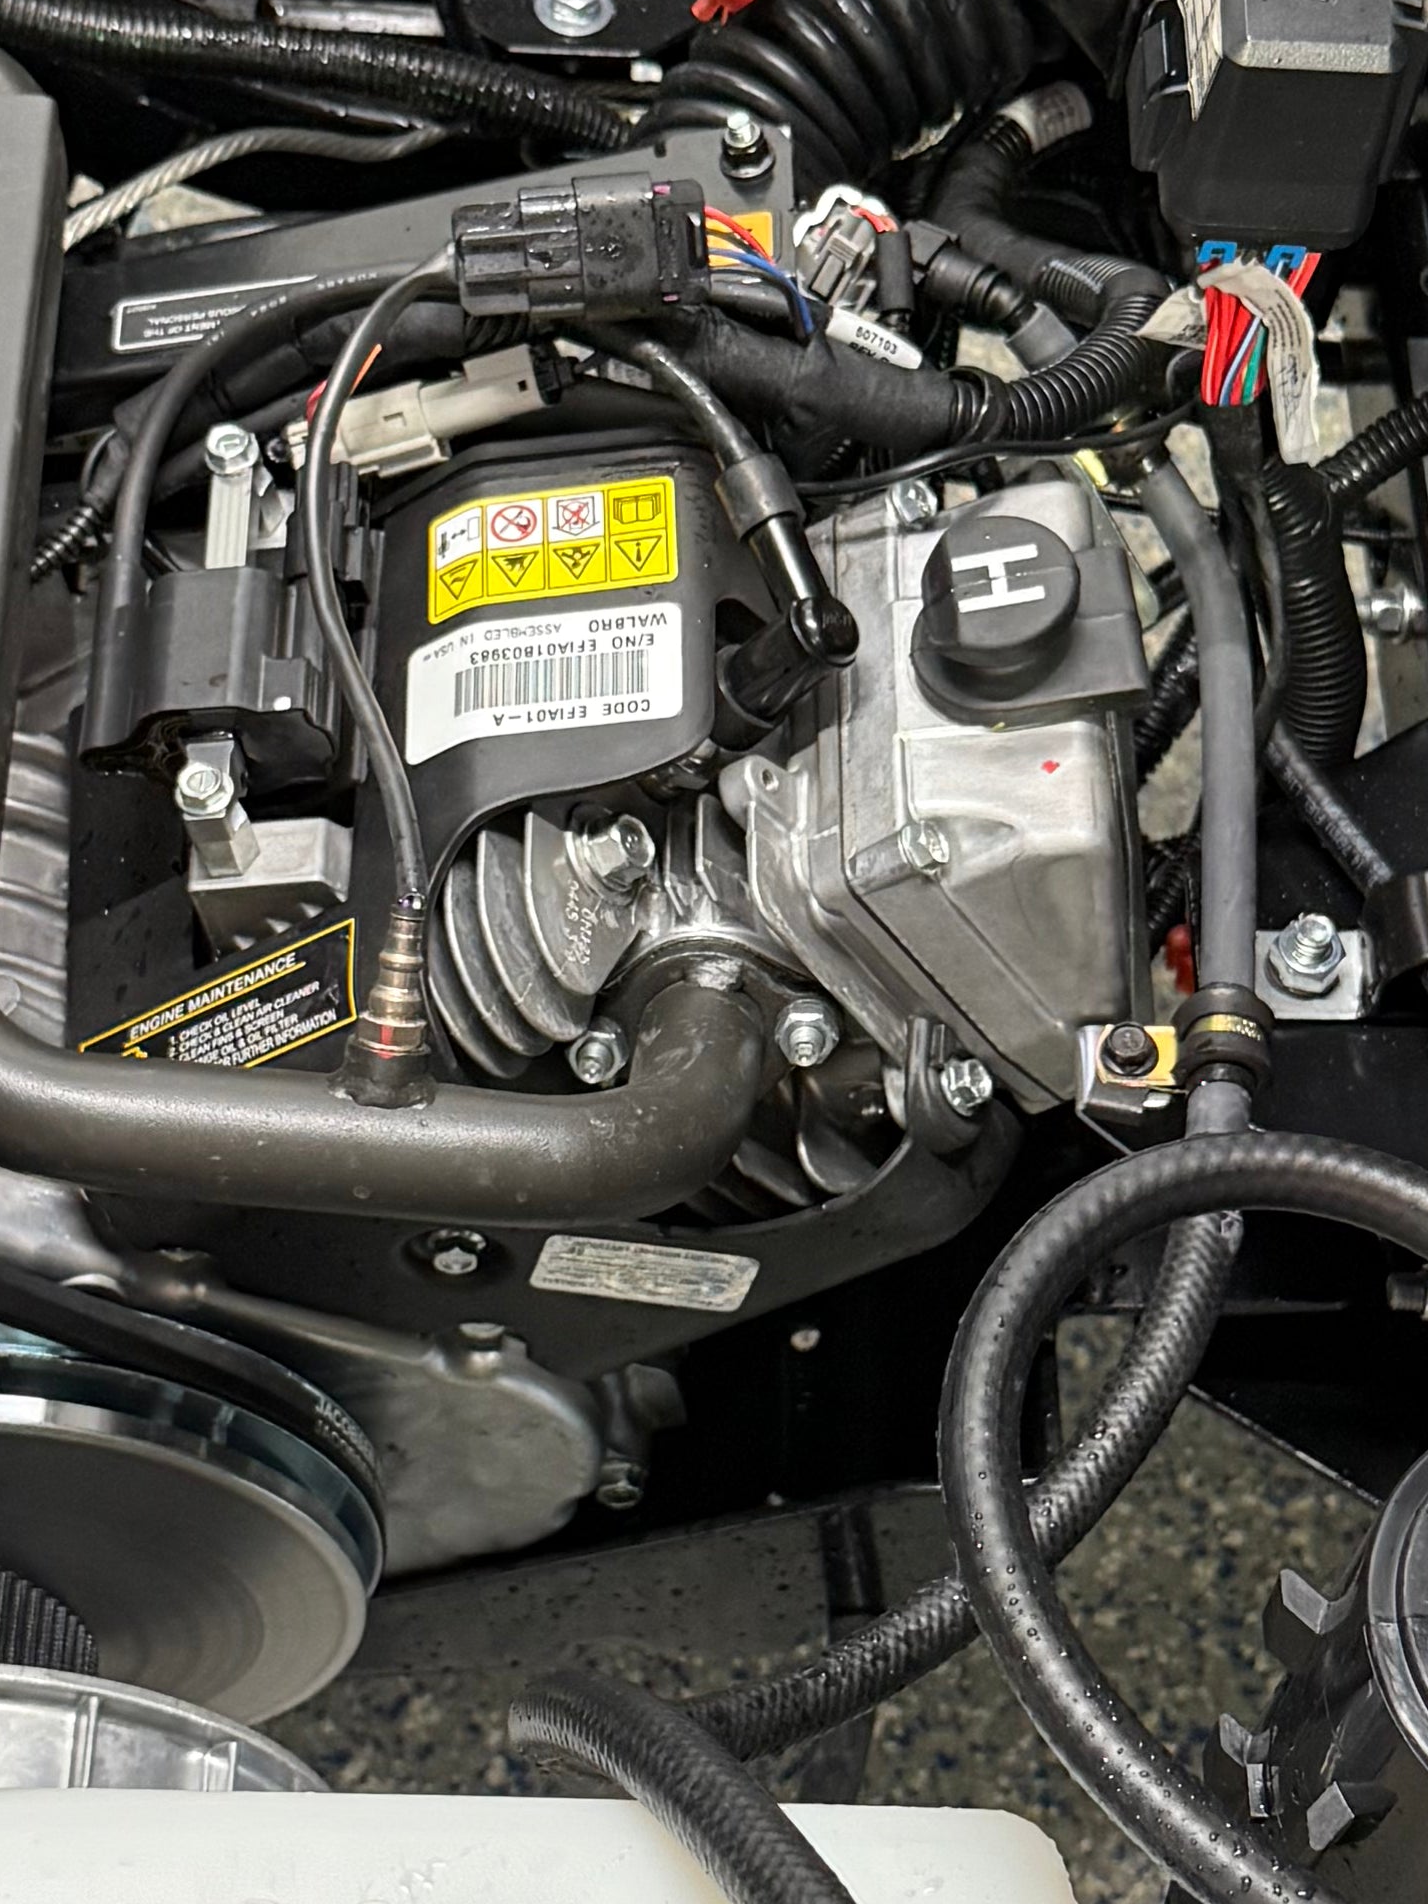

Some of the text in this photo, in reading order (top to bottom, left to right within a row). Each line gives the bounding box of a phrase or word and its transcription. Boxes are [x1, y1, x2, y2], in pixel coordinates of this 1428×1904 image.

[952, 543, 1045, 613] H
[433, 612, 667, 658] WALBRO ASSEMBLED IN USA
[470, 633, 655, 666] E/NO EFIA01B03983
[602, 698, 651, 716] CODE
[129, 952, 297, 1041] ENGINE MAINTENANCE
[179, 1031, 213, 1054] CHECK
[222, 1012, 256, 1036] CLEAN
[256, 1001, 273, 1017] AIR
[273, 980, 320, 1008] CLEANER
[179, 1021, 213, 1042] CHECK
[214, 1013, 230, 1027] OIL
[230, 998, 262, 1018] LEVEL
[213, 1032, 234, 1051] FINS
[244, 1009, 285, 1036] SCREEN
[220, 1042, 236, 1056] OIL
[246, 1031, 262, 1045] OIL
[264, 1012, 300, 1037] FILTER
[232, 1038, 275, 1065] FURTHER
[276, 1008, 337, 1049] INFORMATION
